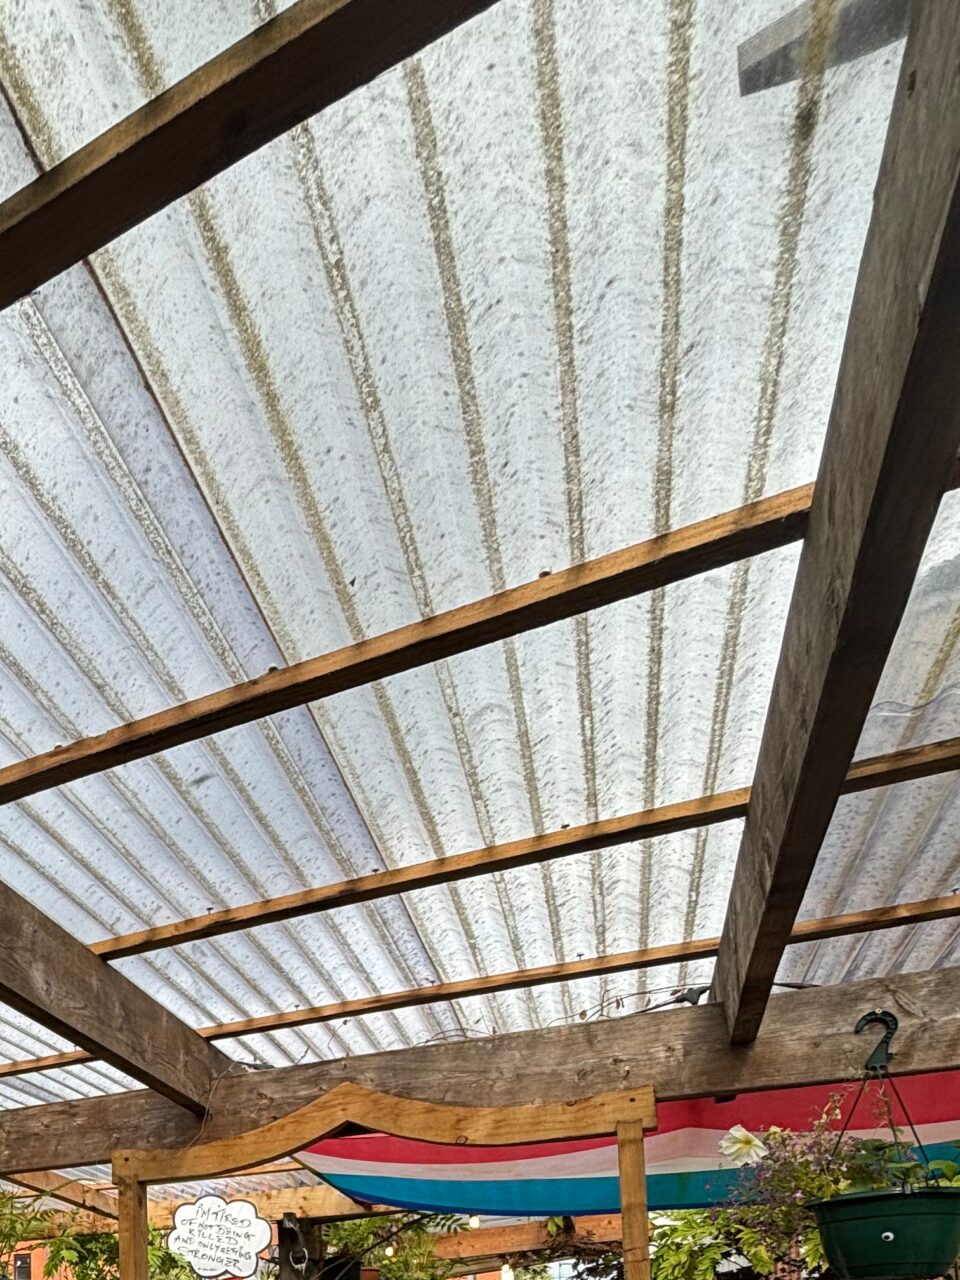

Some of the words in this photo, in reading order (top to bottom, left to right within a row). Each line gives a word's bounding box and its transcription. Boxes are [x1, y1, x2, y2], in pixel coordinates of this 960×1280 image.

[181, 1218, 198, 1226] OF
[216, 1224, 256, 1241] BEING
[174, 1235, 195, 1245] AND
[198, 1241, 220, 1255] ONLY
[178, 1246, 243, 1272] STRONGER
